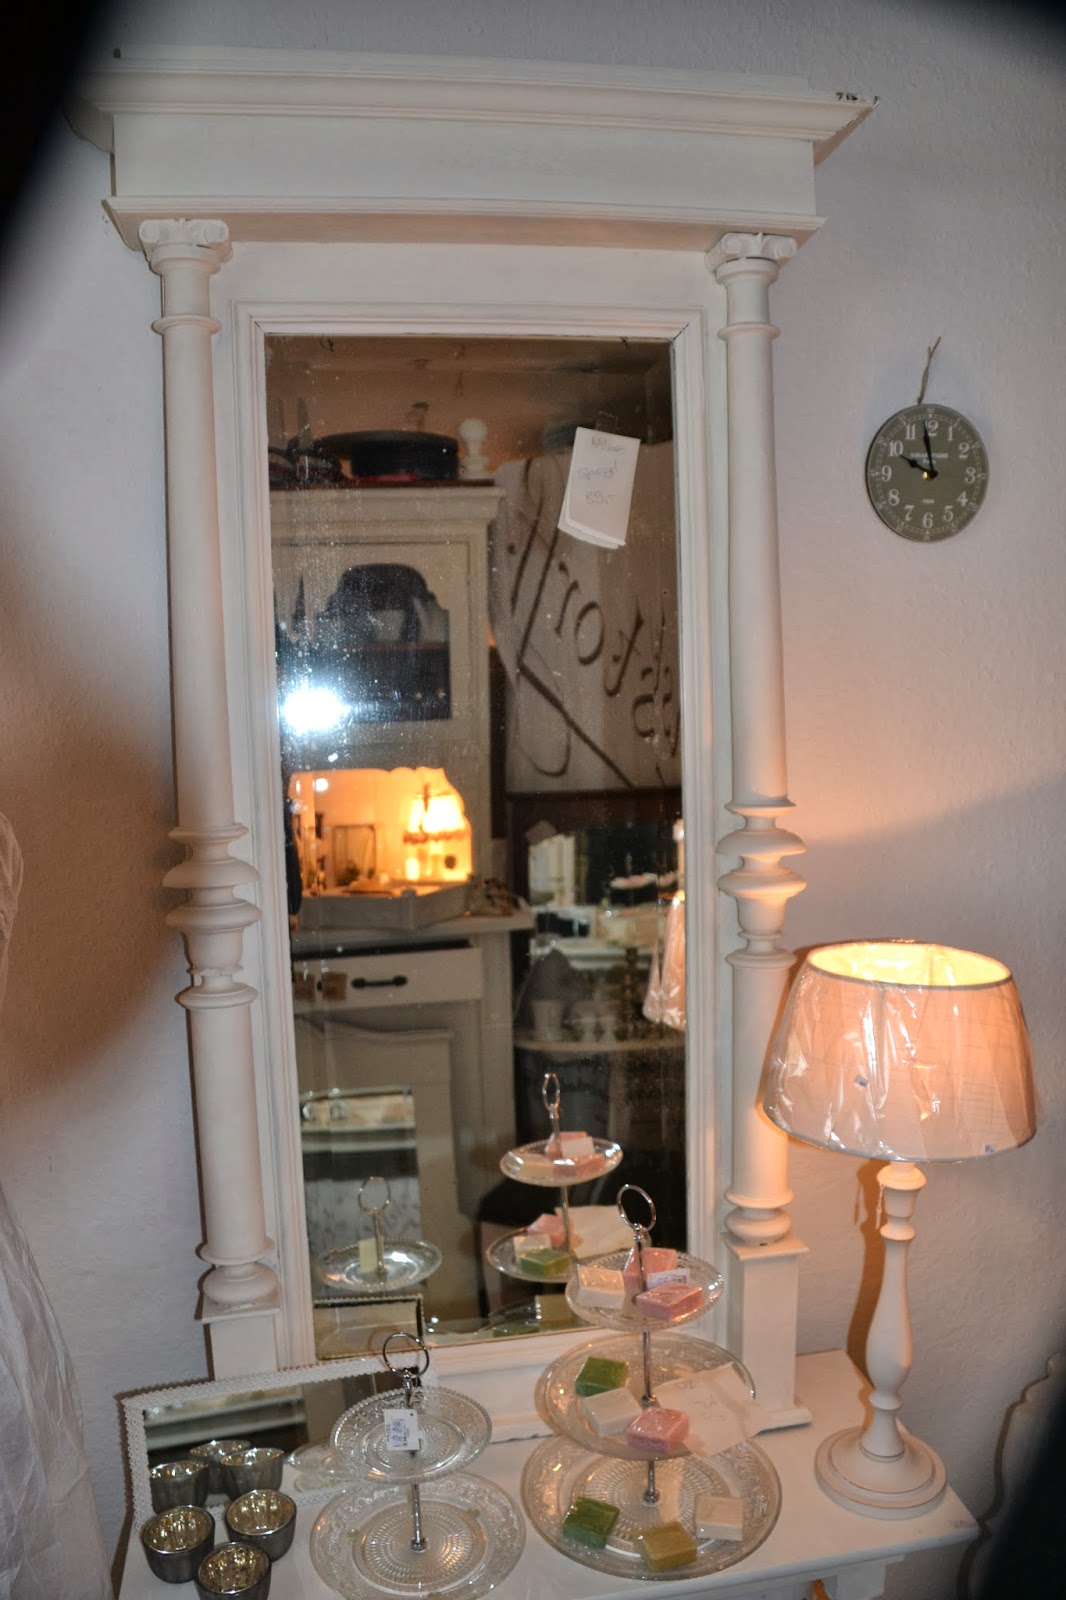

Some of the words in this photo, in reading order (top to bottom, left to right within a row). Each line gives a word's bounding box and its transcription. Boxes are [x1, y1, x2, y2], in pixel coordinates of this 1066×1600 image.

[905, 424, 916, 440] 11
[948, 425, 954, 441] 1
[888, 440, 904, 457] 10
[958, 442, 970, 459] 2
[881, 465, 892, 481] 9
[965, 467, 976, 483] 3
[888, 489, 899, 506] 8
[957, 491, 968, 506] 4
[904, 504, 915, 521] 7
[923, 512, 933, 528] 6
[944, 505, 954, 521] 5
